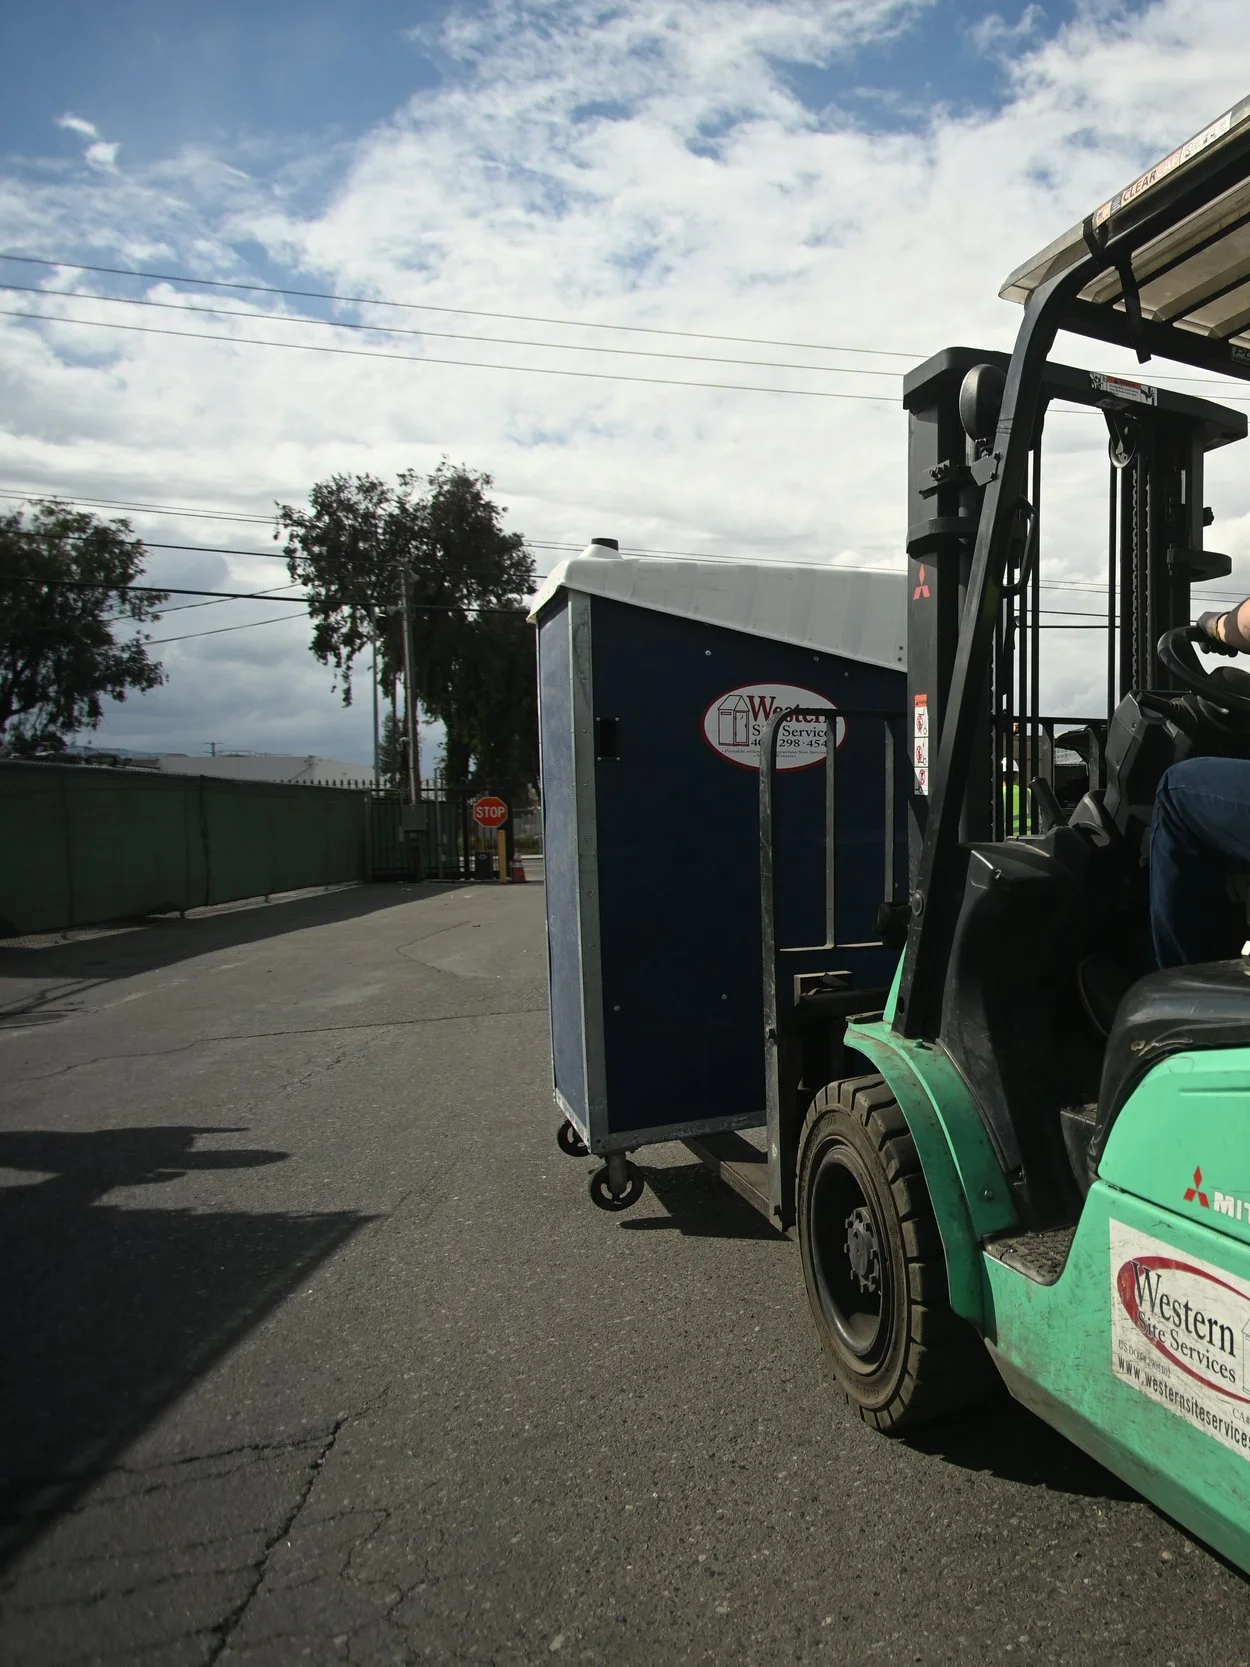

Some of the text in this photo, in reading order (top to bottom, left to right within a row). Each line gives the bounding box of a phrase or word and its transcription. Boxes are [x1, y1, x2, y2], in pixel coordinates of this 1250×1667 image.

[476, 806, 505, 818] STOP
[1131, 1260, 1236, 1358] Western
[1137, 1310, 1236, 1384] Site Services
[1232, 1407, 1250, 1425] CA#
